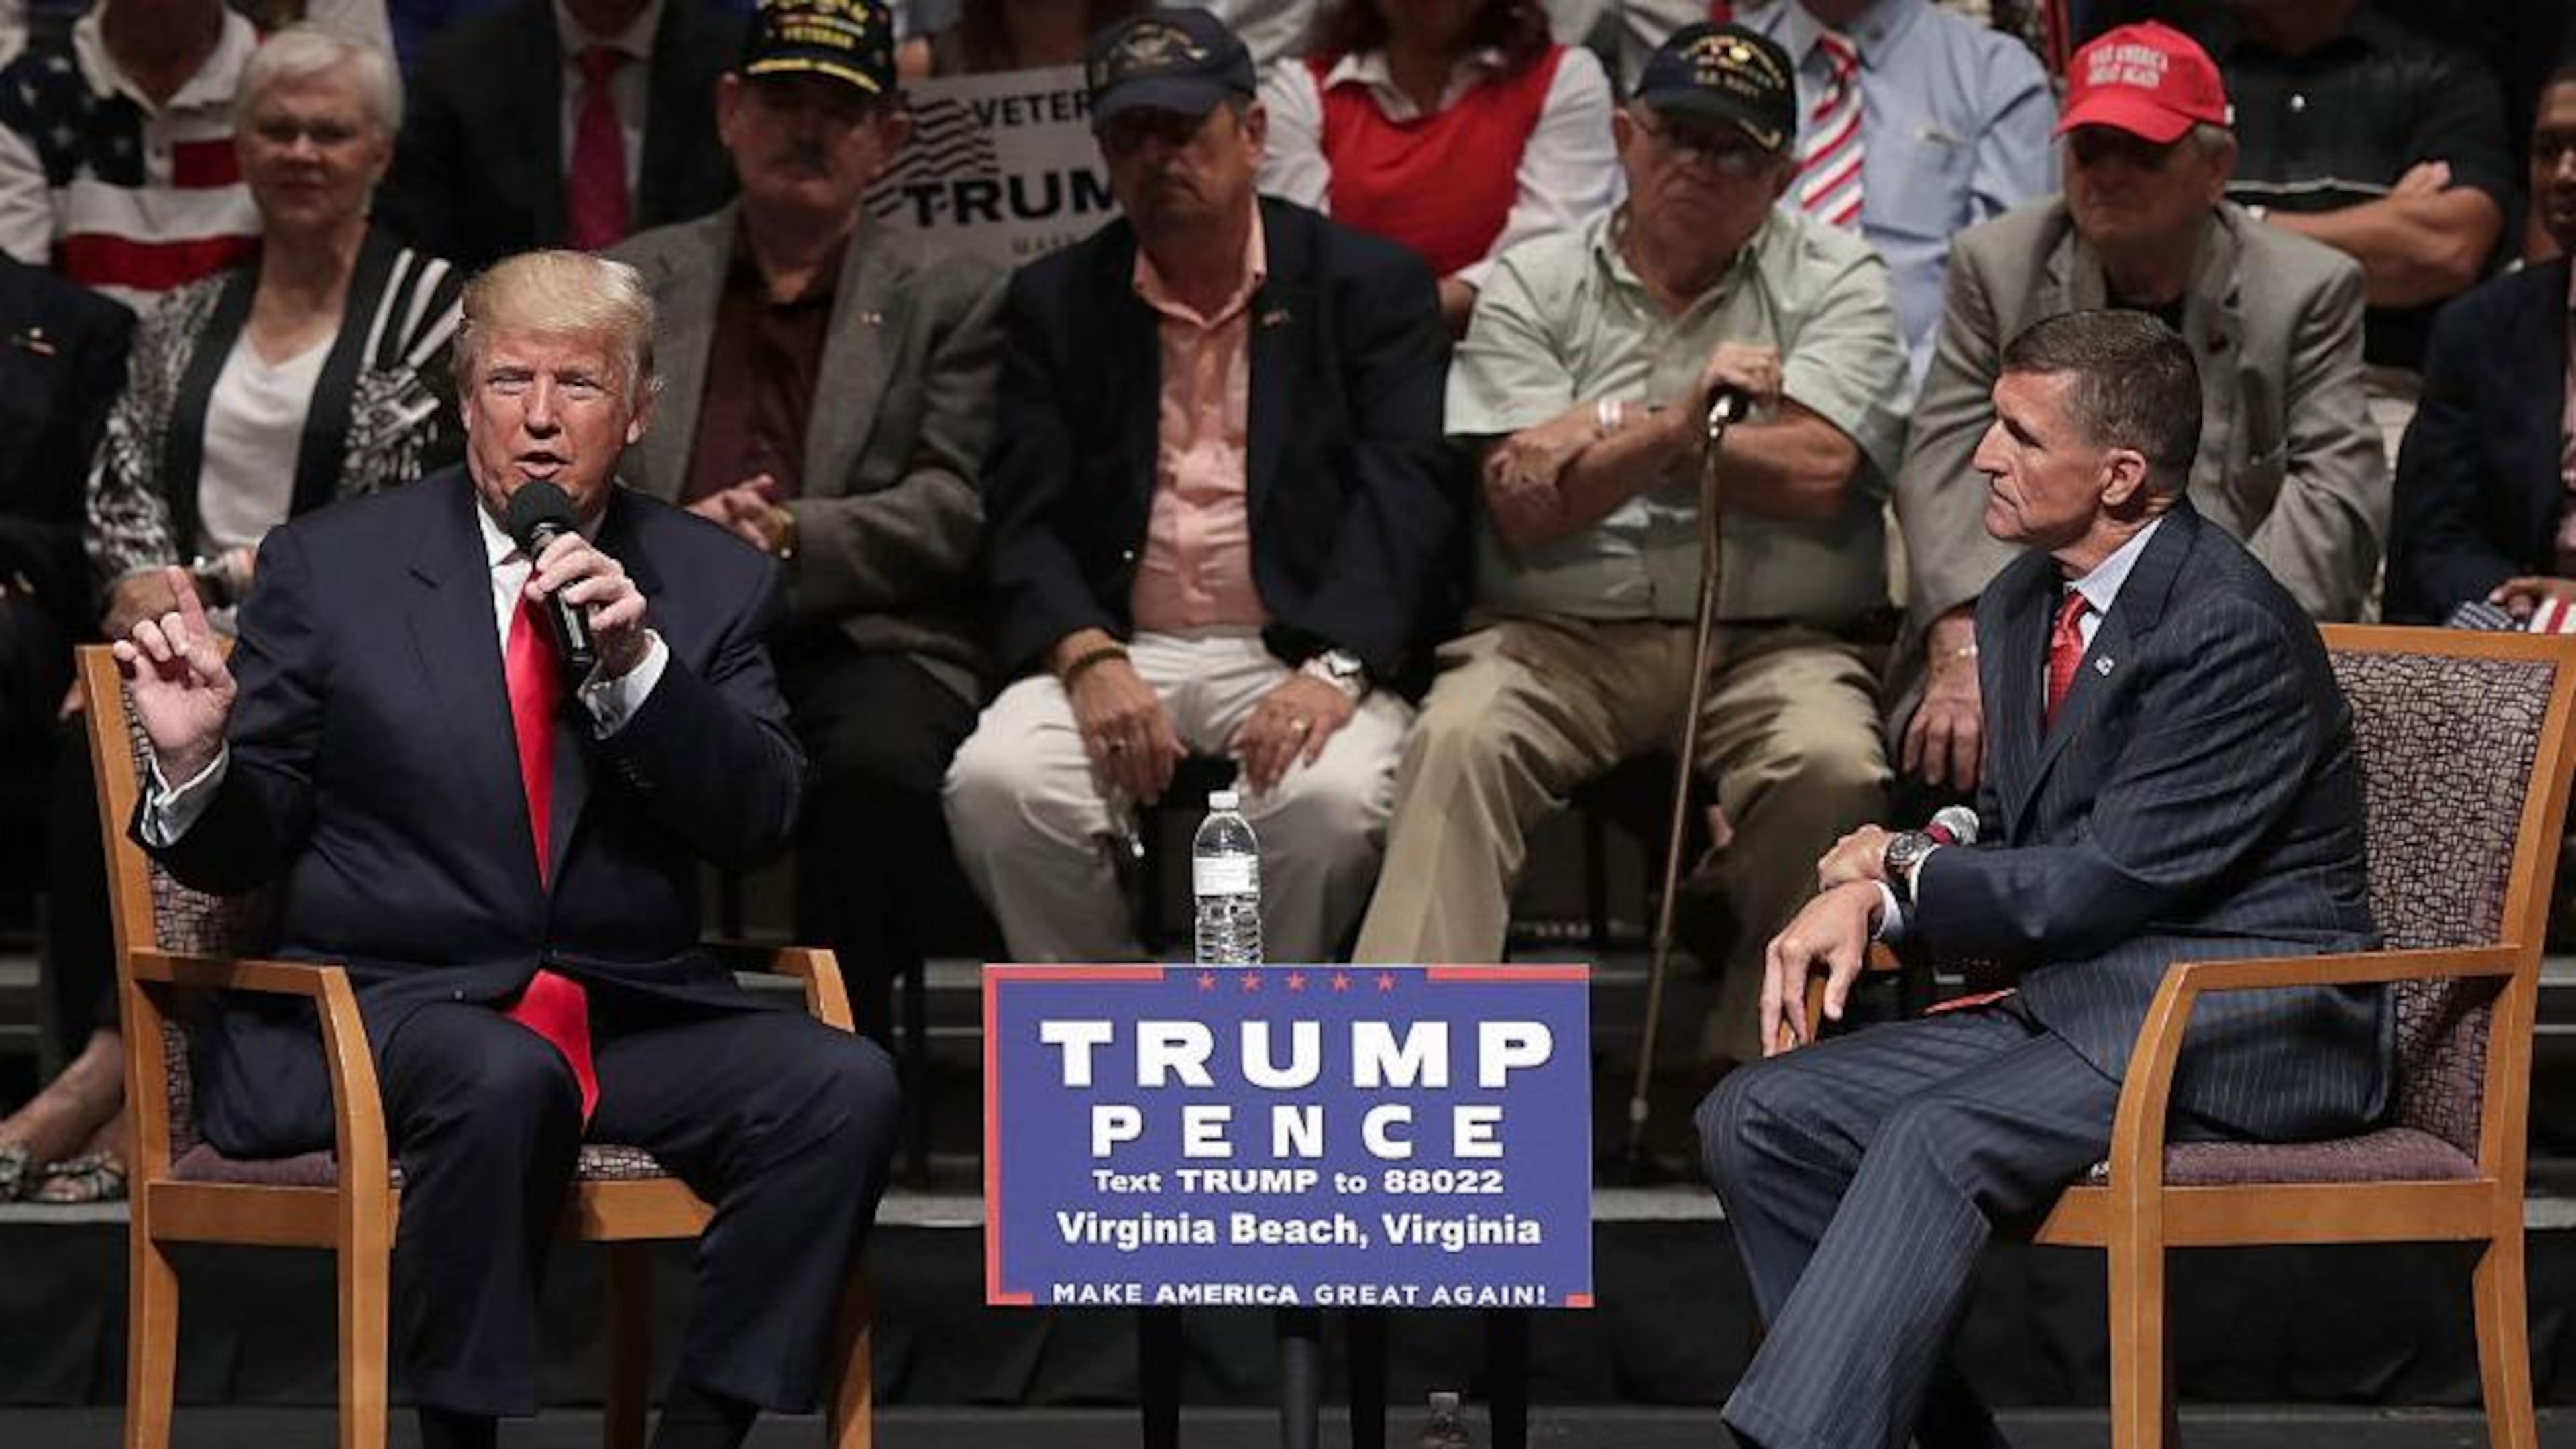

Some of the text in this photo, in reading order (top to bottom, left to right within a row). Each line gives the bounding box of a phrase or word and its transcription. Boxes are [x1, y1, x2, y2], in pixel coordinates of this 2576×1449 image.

[2115, 44, 2169, 73] AMERICA
[973, 90, 1091, 128] VETER
[902, 169, 1113, 229] TRUM
[1040, 1020, 1554, 1089] TRUMP
[1091, 1104, 1504, 1159] PENCE
[1093, 1169, 1503, 1194] Text TRUMP to 88022
[1057, 1210, 1542, 1252] Virginia Beach, Virginia
[1053, 1283, 1546, 1306] MAKE AMERICA GREAT AGAIN!
